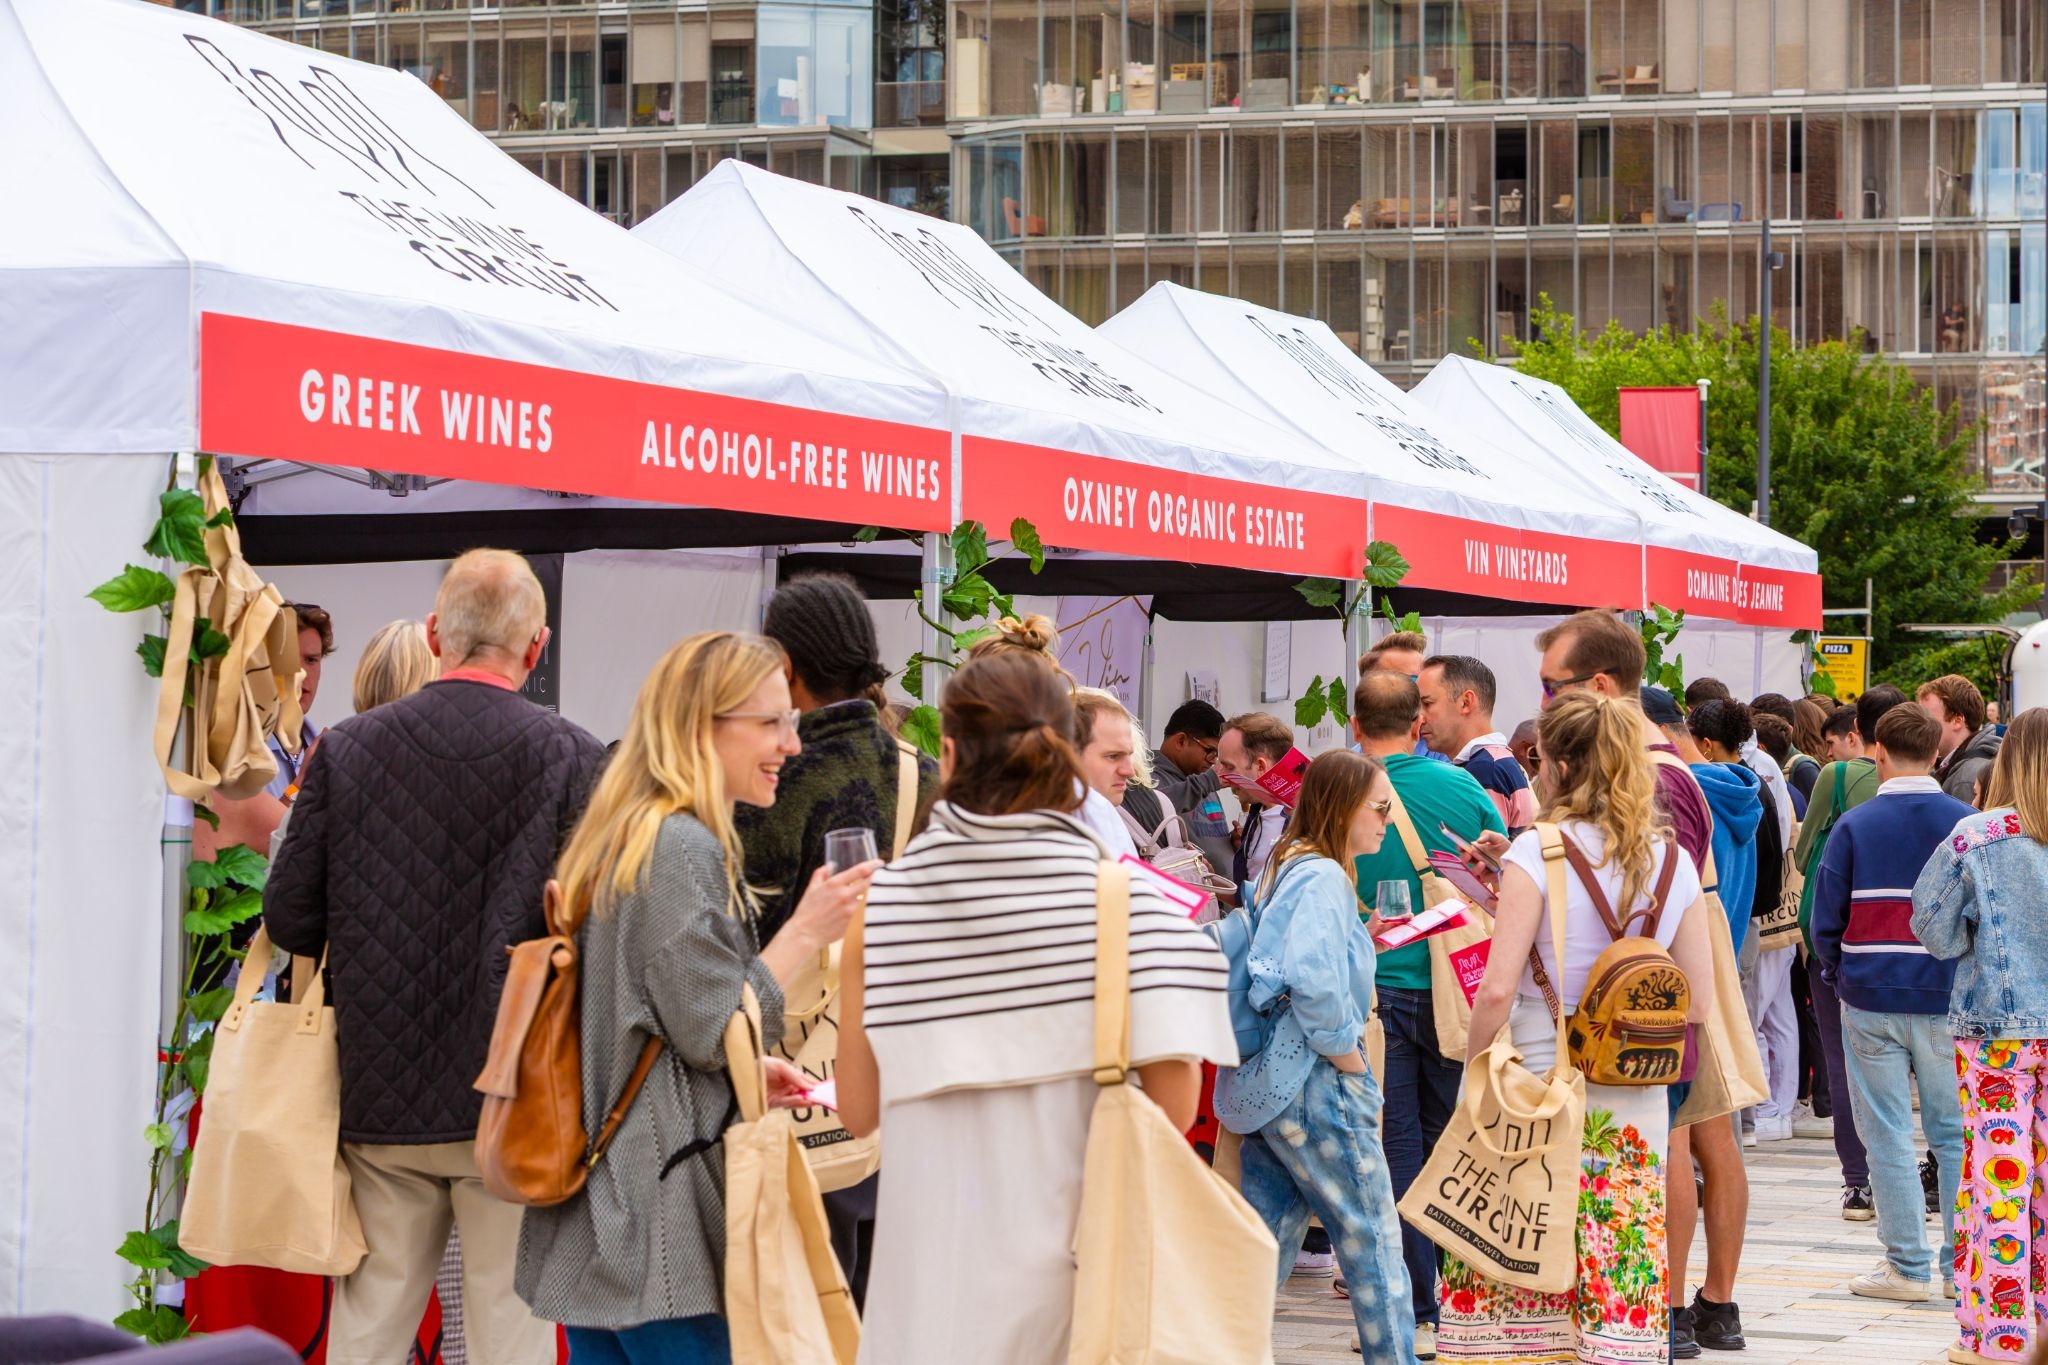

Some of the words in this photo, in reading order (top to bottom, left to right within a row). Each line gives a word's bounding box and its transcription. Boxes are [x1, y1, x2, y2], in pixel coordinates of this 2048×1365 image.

[338, 190, 455, 242] THE
[421, 206, 568, 268] WINE
[409, 240, 620, 312] CIRCUIT
[978, 324, 1056, 363] THE
[299, 368, 422, 435] GREEK
[440, 389, 553, 453] WINES
[1032, 362, 1164, 414] CIRCUIT
[640, 420, 848, 489] ALCOHOL-FREE
[861, 450, 940, 501] WINES
[1063, 476, 1138, 529] OXNEY
[1148, 490, 1236, 543] ORGANIC
[1245, 505, 1304, 550] ESTATE
[1464, 538, 1489, 576] VIN
[1495, 544, 1568, 586] VINEYARDS
[1687, 568, 1730, 603] DOMAINE
[1732, 576, 1749, 609] DES
[1750, 581, 1784, 612] JEANNE
[1824, 644, 1849, 654] PIZZA
[1451, 1149, 1500, 1197] THE
[1426, 1206, 1471, 1240] BATTERSEA
[1472, 1237, 1501, 1261] POWER
[1500, 1256, 1538, 1272] STATION
[1438, 1175, 1548, 1252] CIRCUIT
